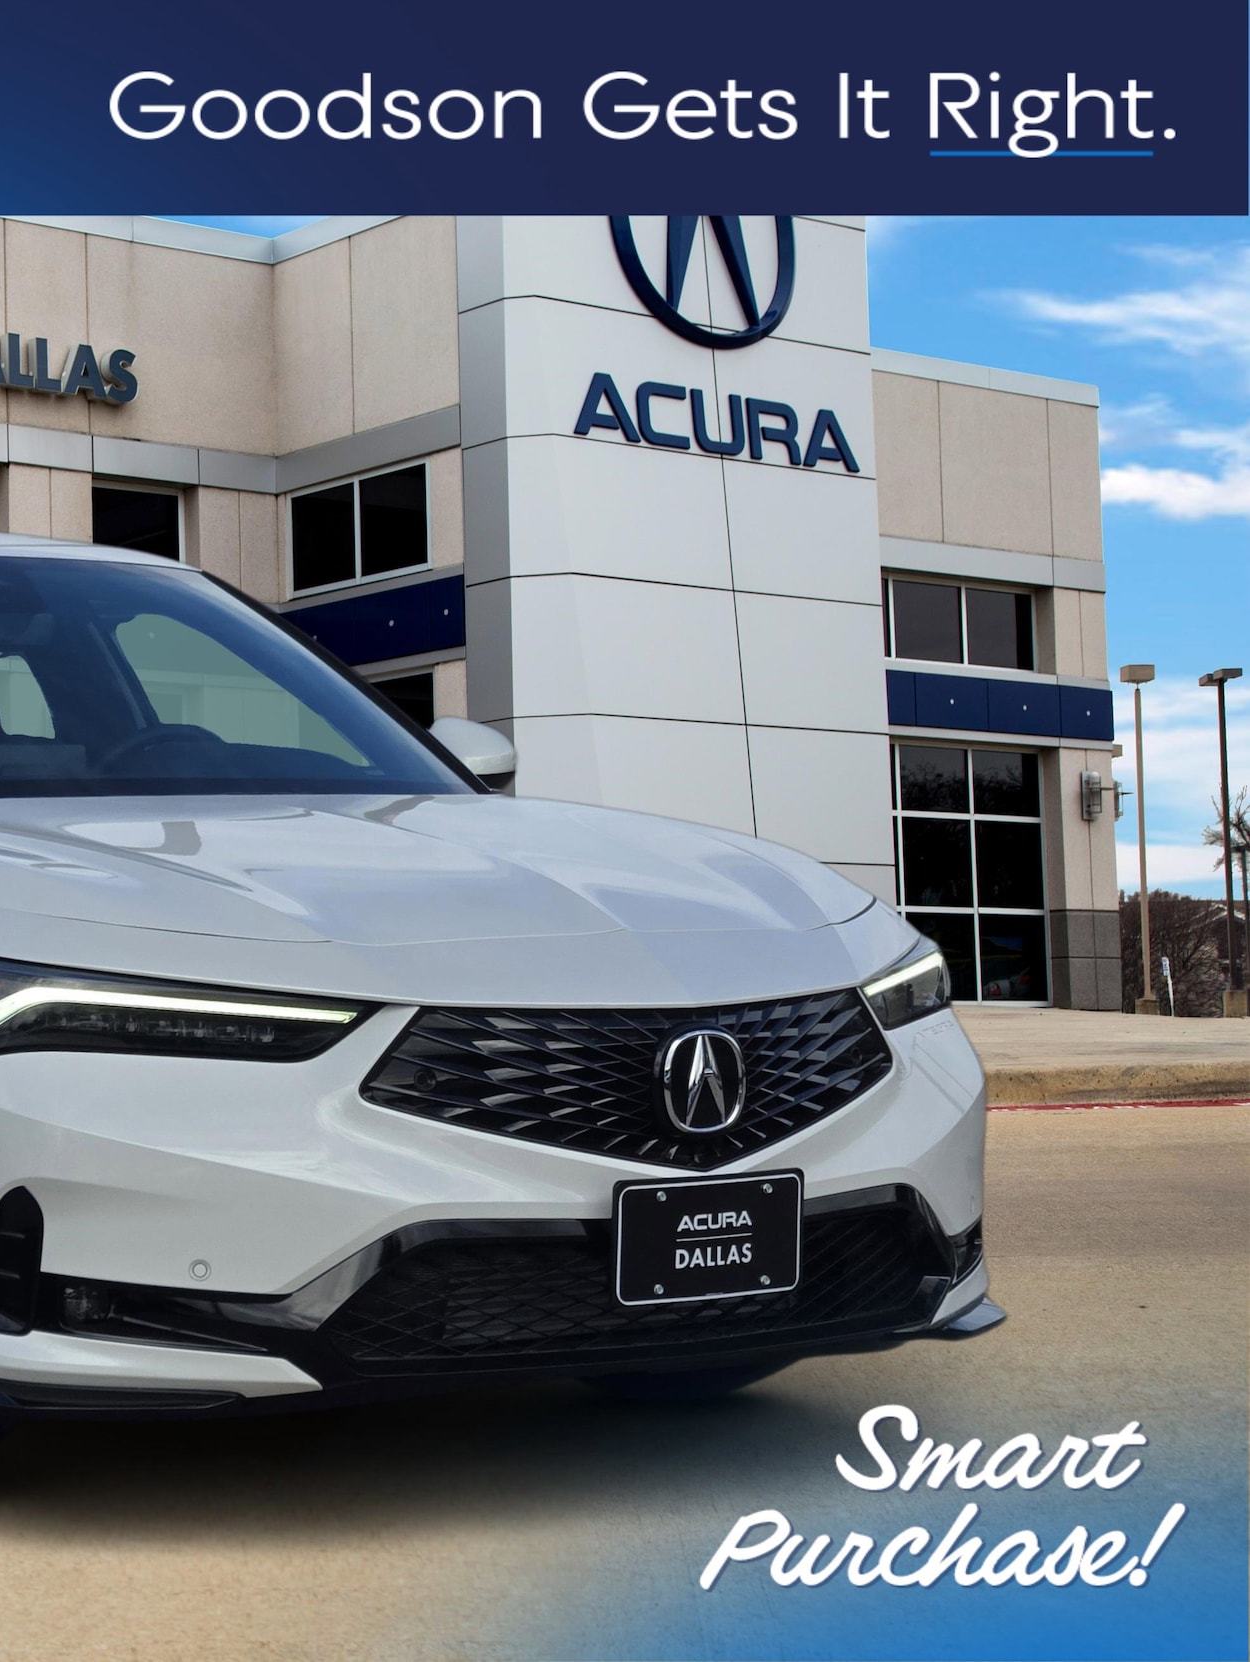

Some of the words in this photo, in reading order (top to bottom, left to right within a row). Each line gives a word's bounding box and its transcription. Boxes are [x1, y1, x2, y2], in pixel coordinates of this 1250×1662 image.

[573, 371, 861, 474] ACURA
[676, 1210, 753, 1233] ACURA
[674, 1243, 753, 1270] DALLAS
